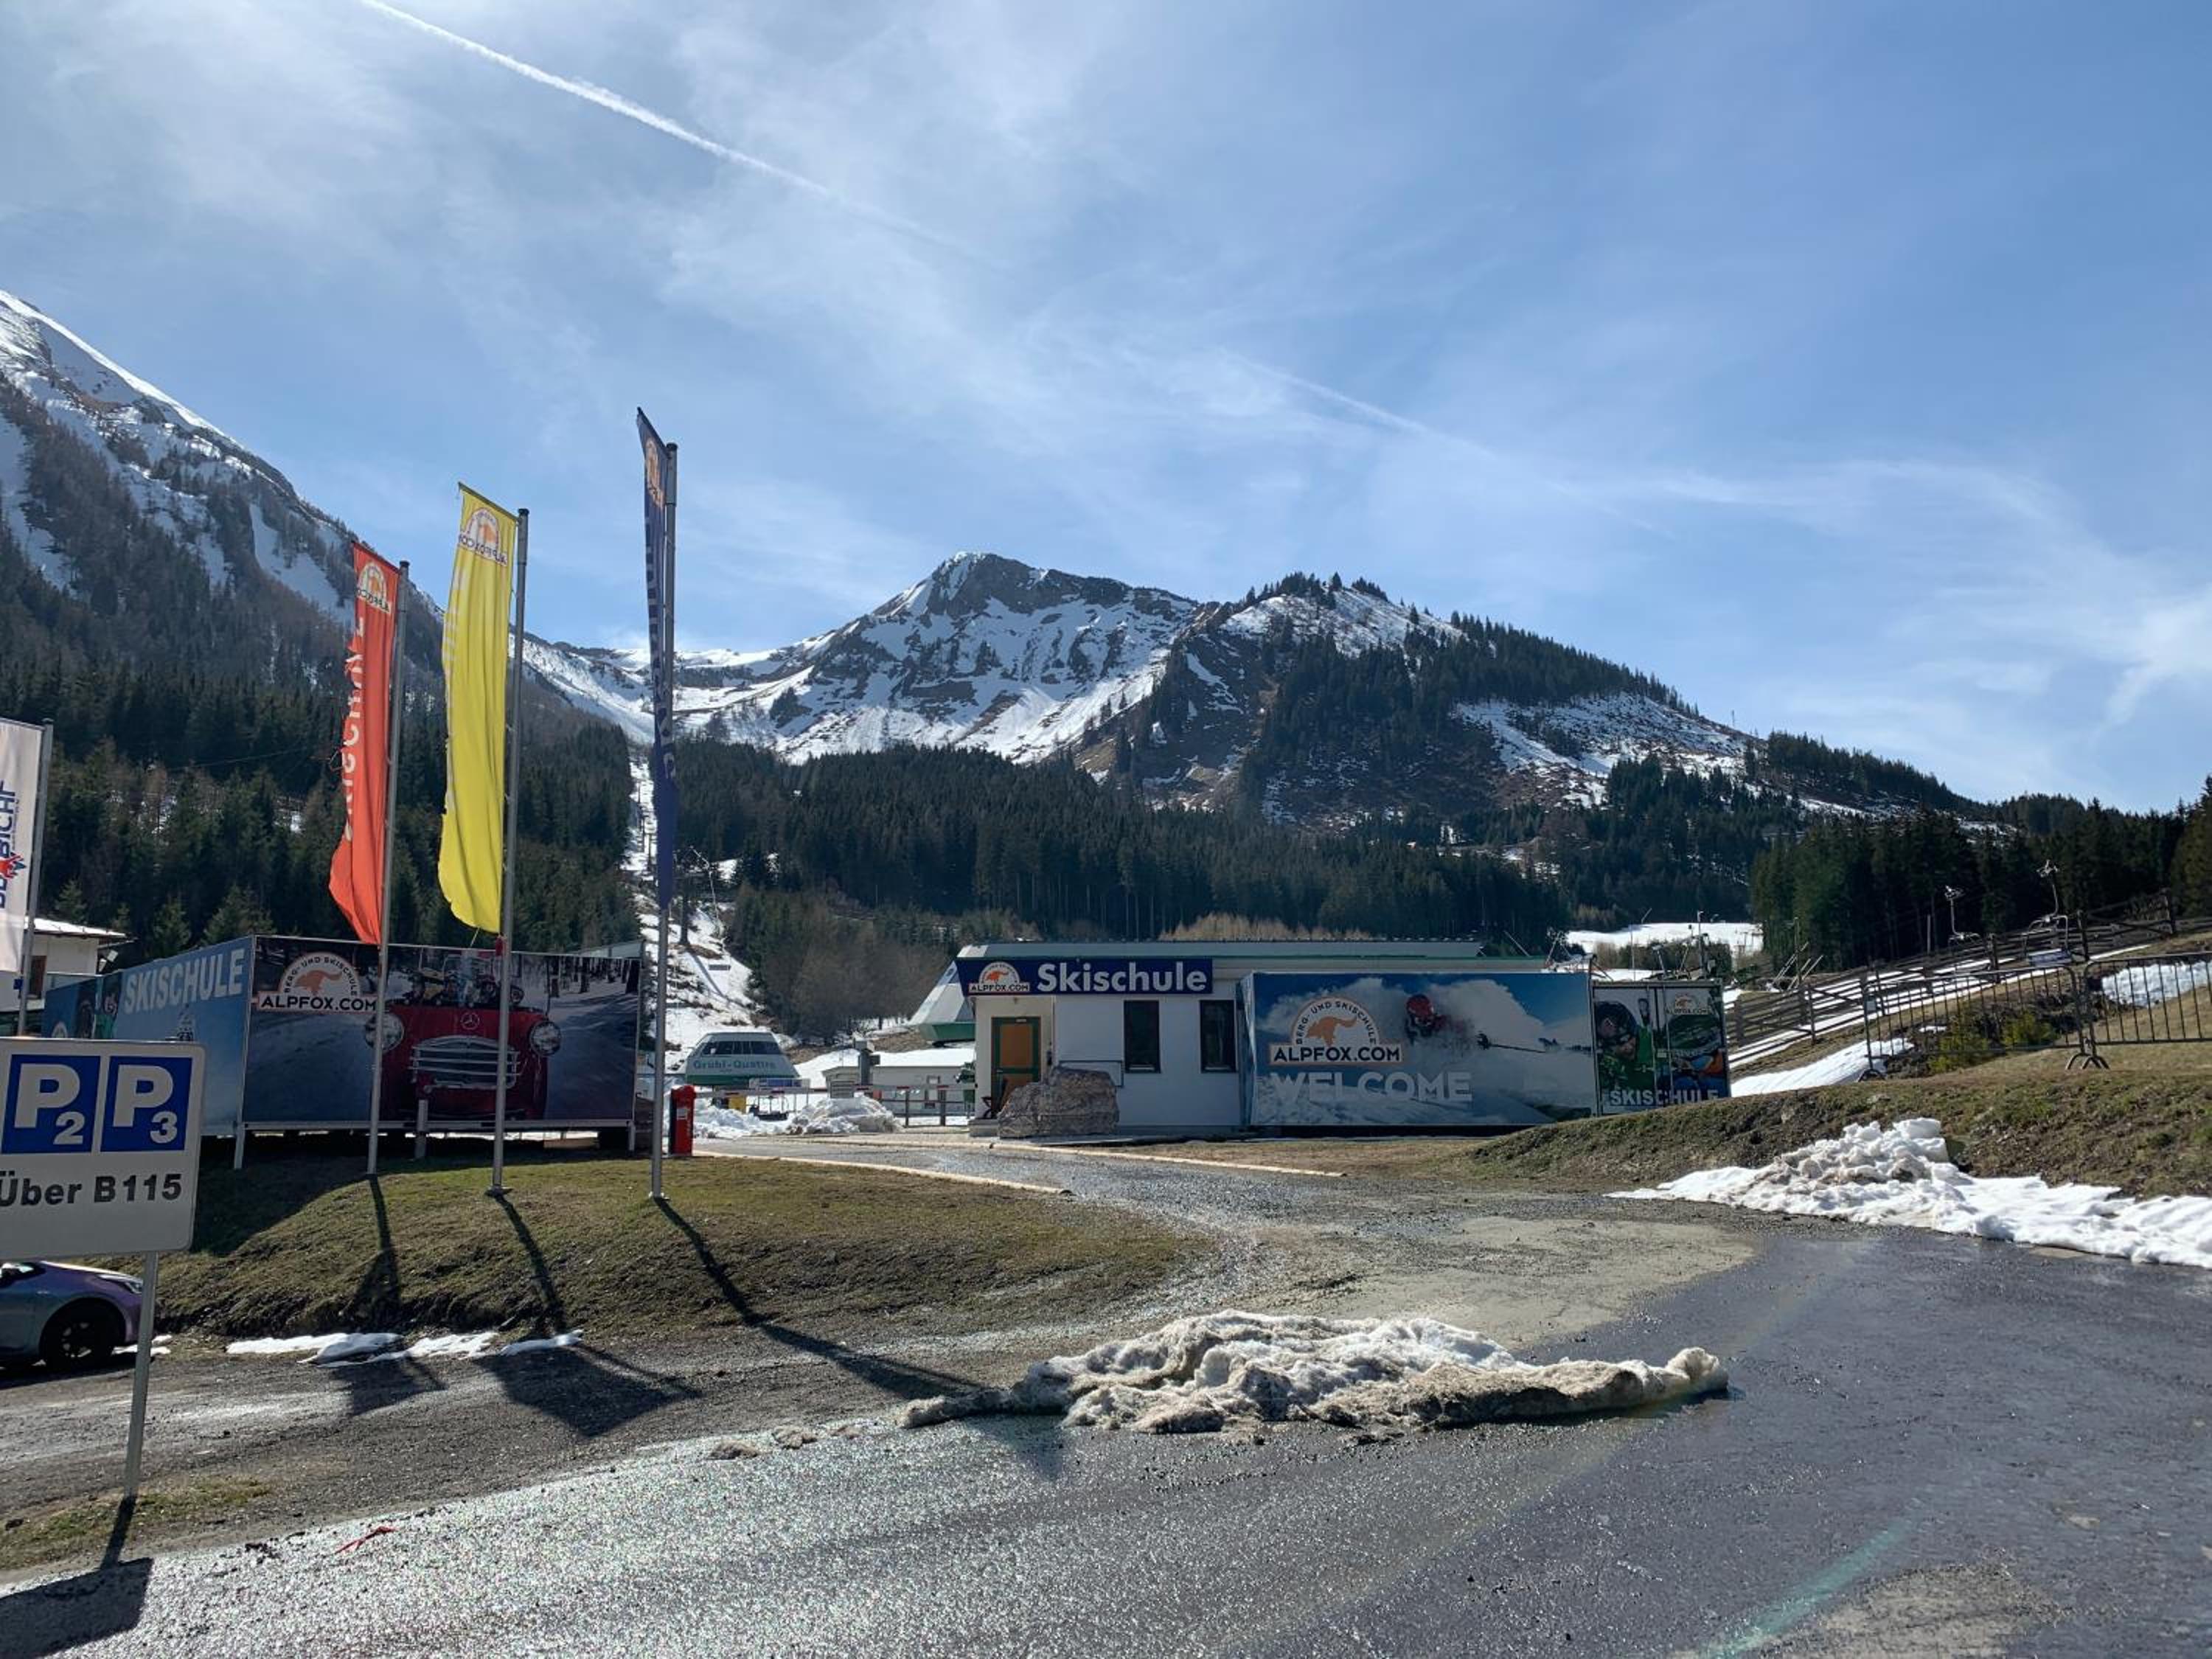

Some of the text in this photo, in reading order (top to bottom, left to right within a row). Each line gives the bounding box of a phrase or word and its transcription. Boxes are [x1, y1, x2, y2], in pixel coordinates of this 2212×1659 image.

[124, 948, 246, 1015] SKISCHULE
[1037, 961, 1207, 992] Skischule
[261, 996, 376, 1011] ALPFOX.COM
[1312, 1001, 1332, 1015] UND
[1335, 1001, 1377, 1045] SKISCHULE
[1273, 1046, 1400, 1062] ALPFOX.COM
[1270, 1071, 1472, 1102] WELCOME
[0, 1170, 182, 1207] Über B115
